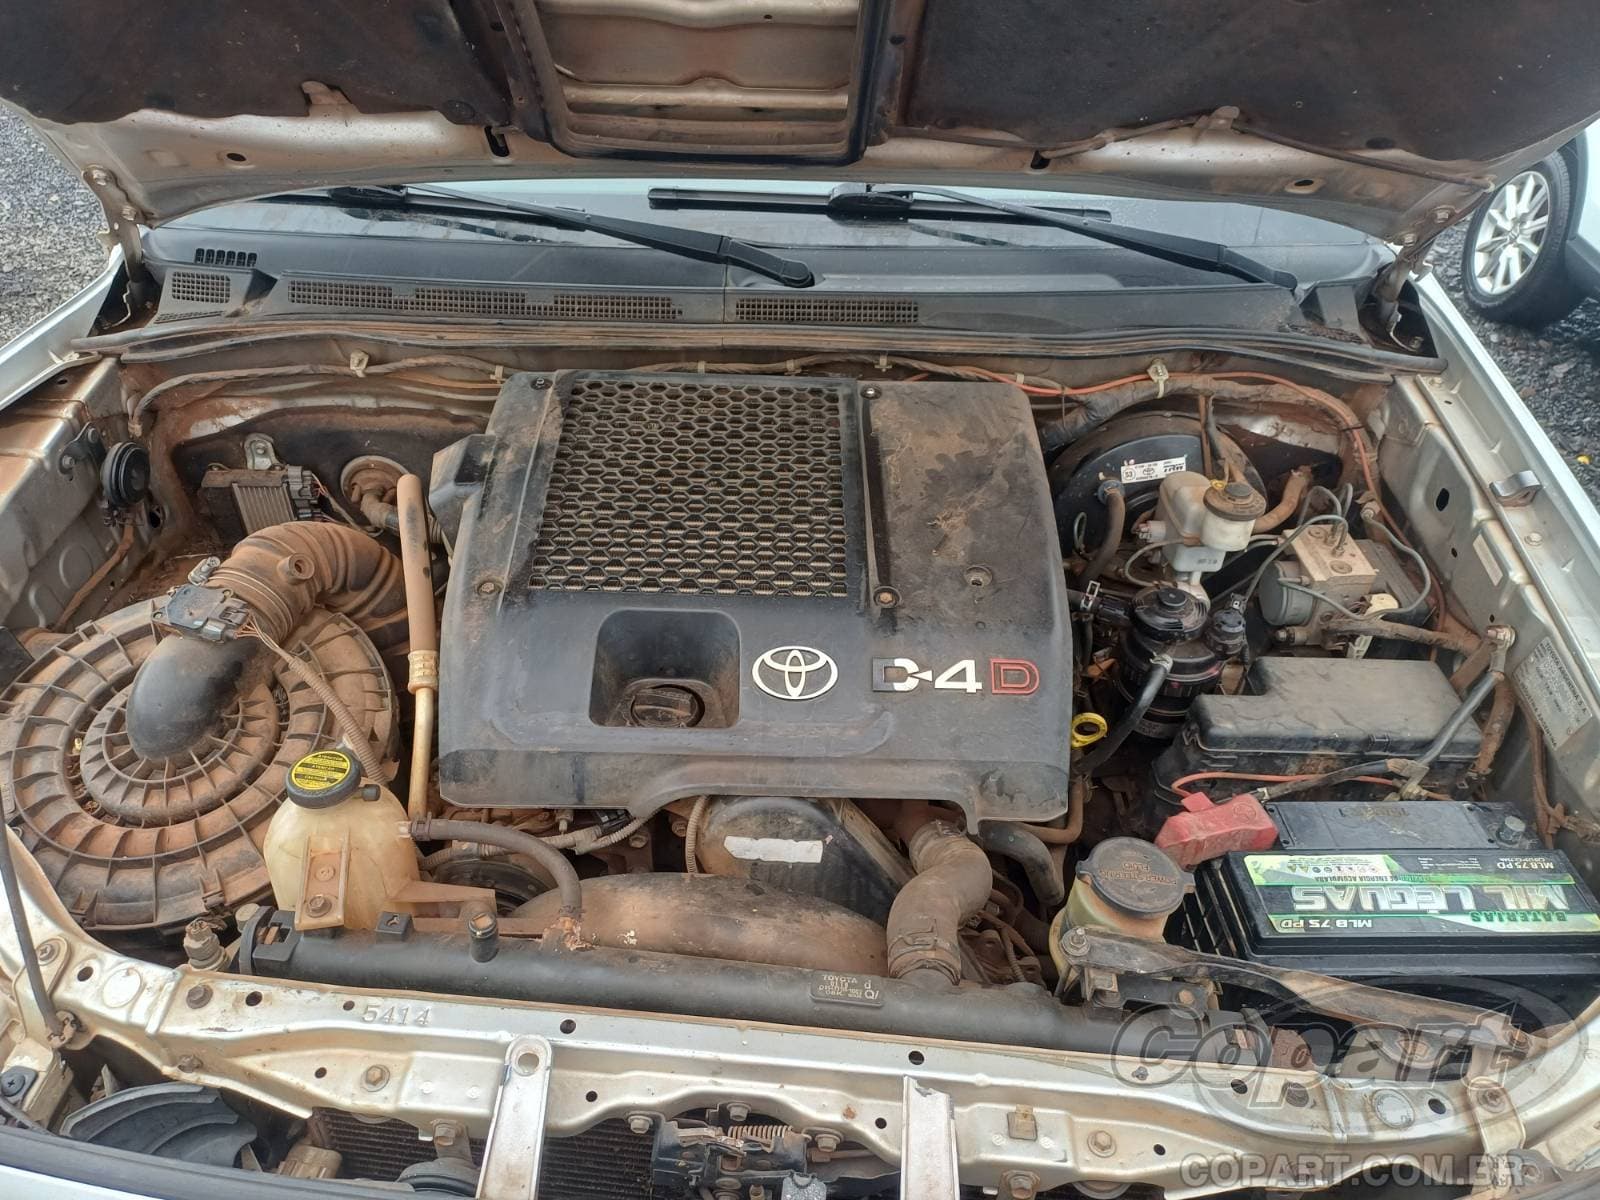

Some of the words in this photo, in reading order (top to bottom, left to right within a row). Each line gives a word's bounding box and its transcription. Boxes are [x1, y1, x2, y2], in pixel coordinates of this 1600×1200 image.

[1497, 861, 1513, 869] PD
[1484, 884, 1569, 911] MIL
[1470, 911, 1567, 922] BATERIAS
[1281, 919, 1305, 928] PD
[1309, 919, 1330, 928] 75
[1333, 919, 1372, 928] MLB
[822, 974, 858, 984] TOYOTA
[362, 1004, 432, 1025] 5414
